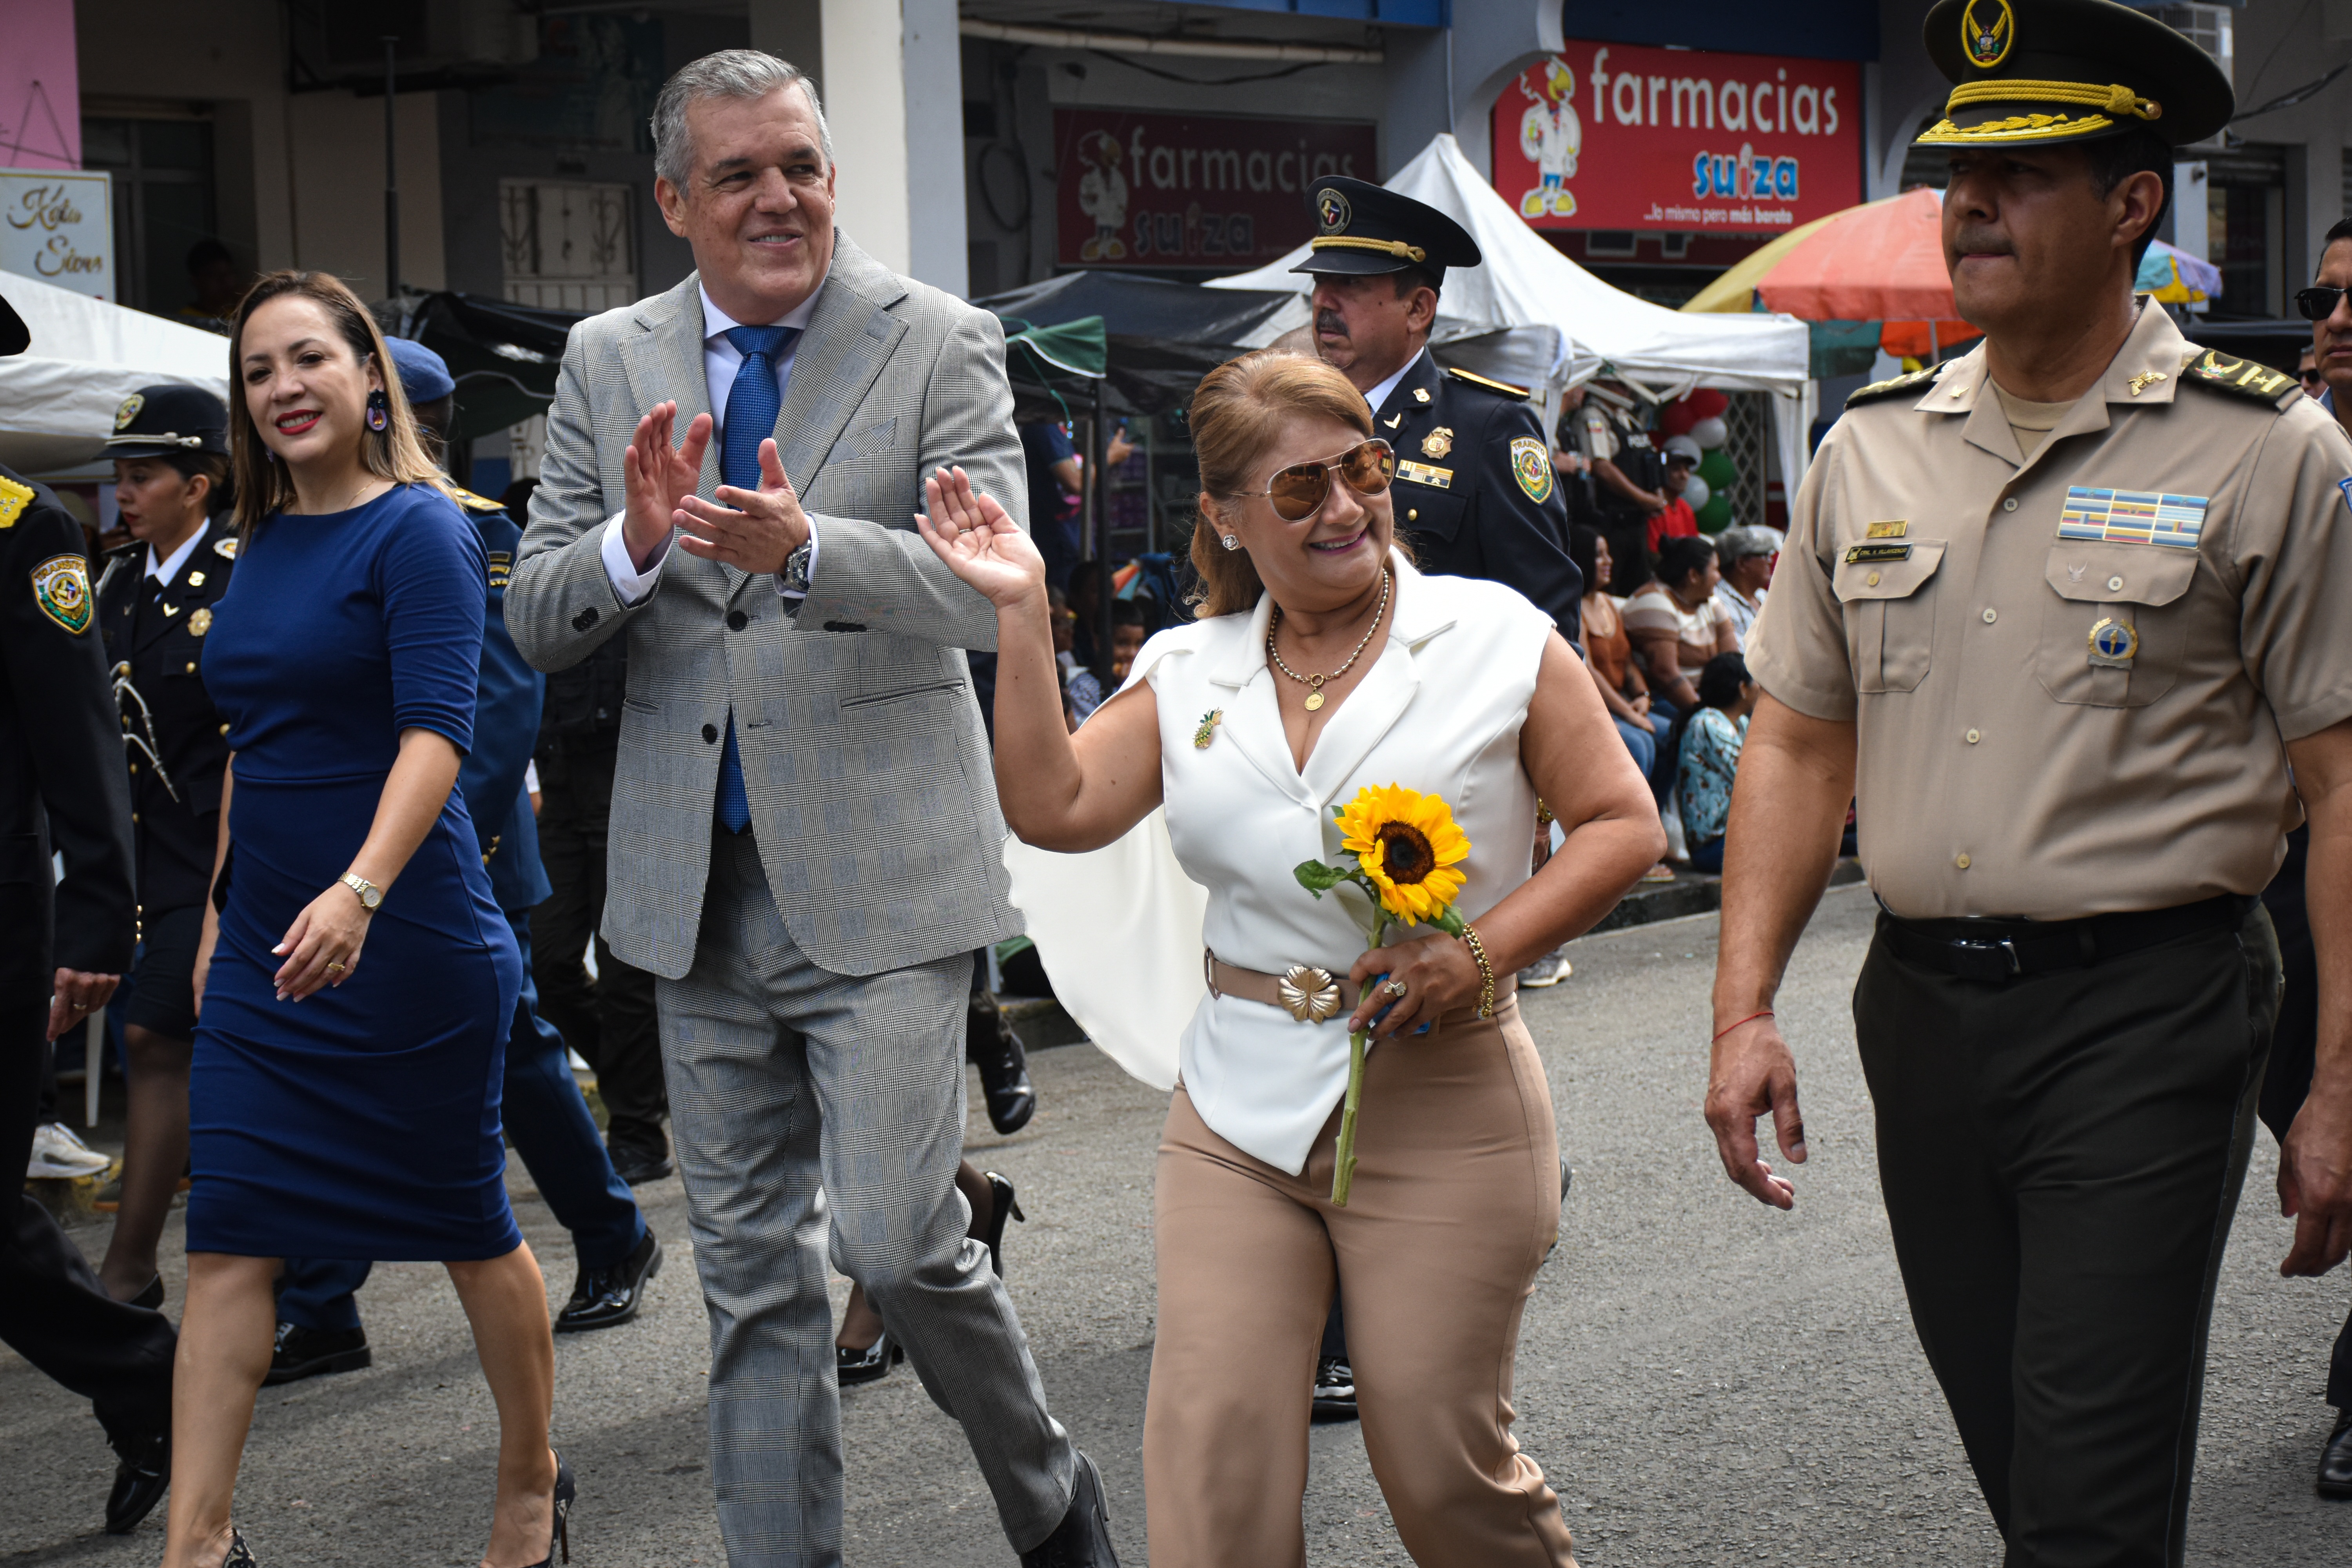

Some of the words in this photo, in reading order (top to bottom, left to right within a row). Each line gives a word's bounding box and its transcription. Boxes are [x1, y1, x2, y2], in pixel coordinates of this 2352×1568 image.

[1590, 47, 1838, 135] farmacias
[1130, 125, 1354, 191] farmacias
[1693, 143, 1798, 201] suiza
[1133, 200, 1255, 257] suiza
[1664, 203, 1702, 222] mismo
[1702, 208, 1728, 225] pero
[1754, 205, 1793, 225] barato
[1513, 440, 1545, 456] TRANSITO
[35, 560, 83, 582] TRANSITO
